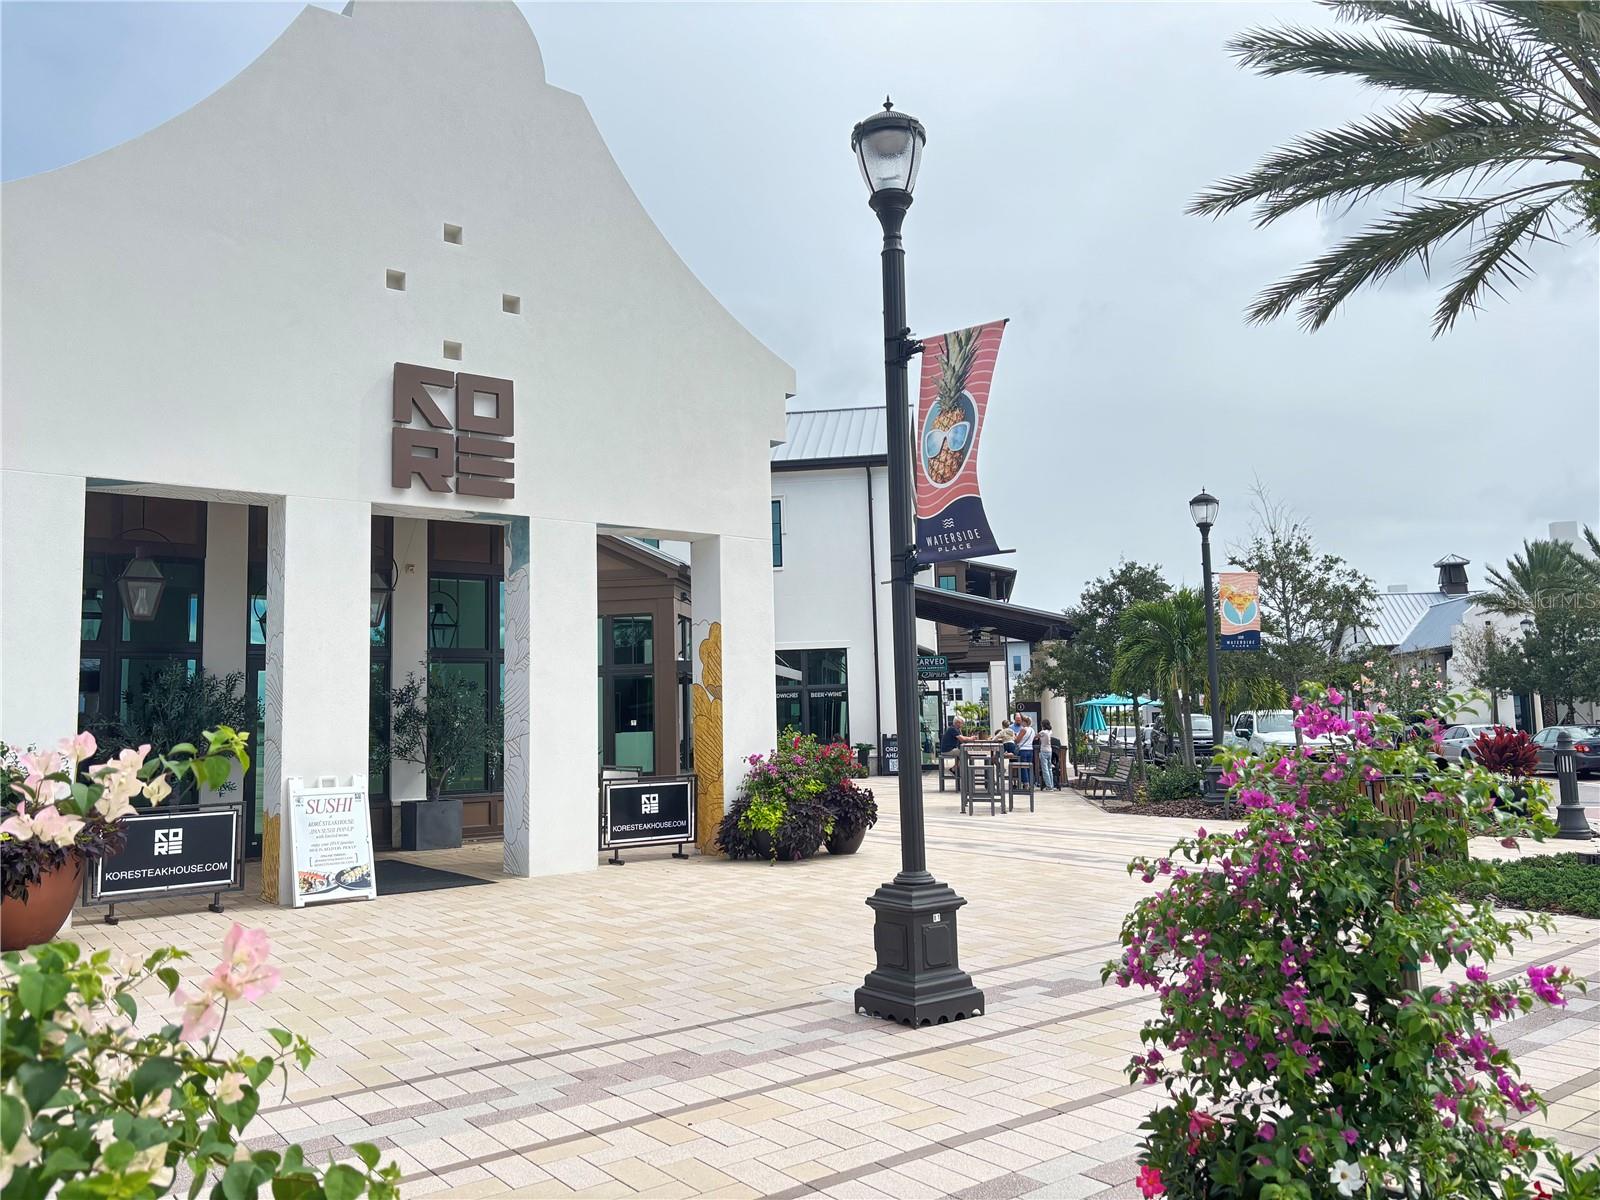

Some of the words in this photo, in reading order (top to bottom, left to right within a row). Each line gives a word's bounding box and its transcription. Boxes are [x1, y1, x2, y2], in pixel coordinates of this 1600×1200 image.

[925, 528, 981, 547] WATERSIDE
[937, 542, 972, 553] PLACE
[305, 797, 353, 815] SUSHI
[612, 820, 687, 832] KORESTEAKHOUSE.COM
[105, 861, 228, 881] KORESTEAKHOUSE.COM
